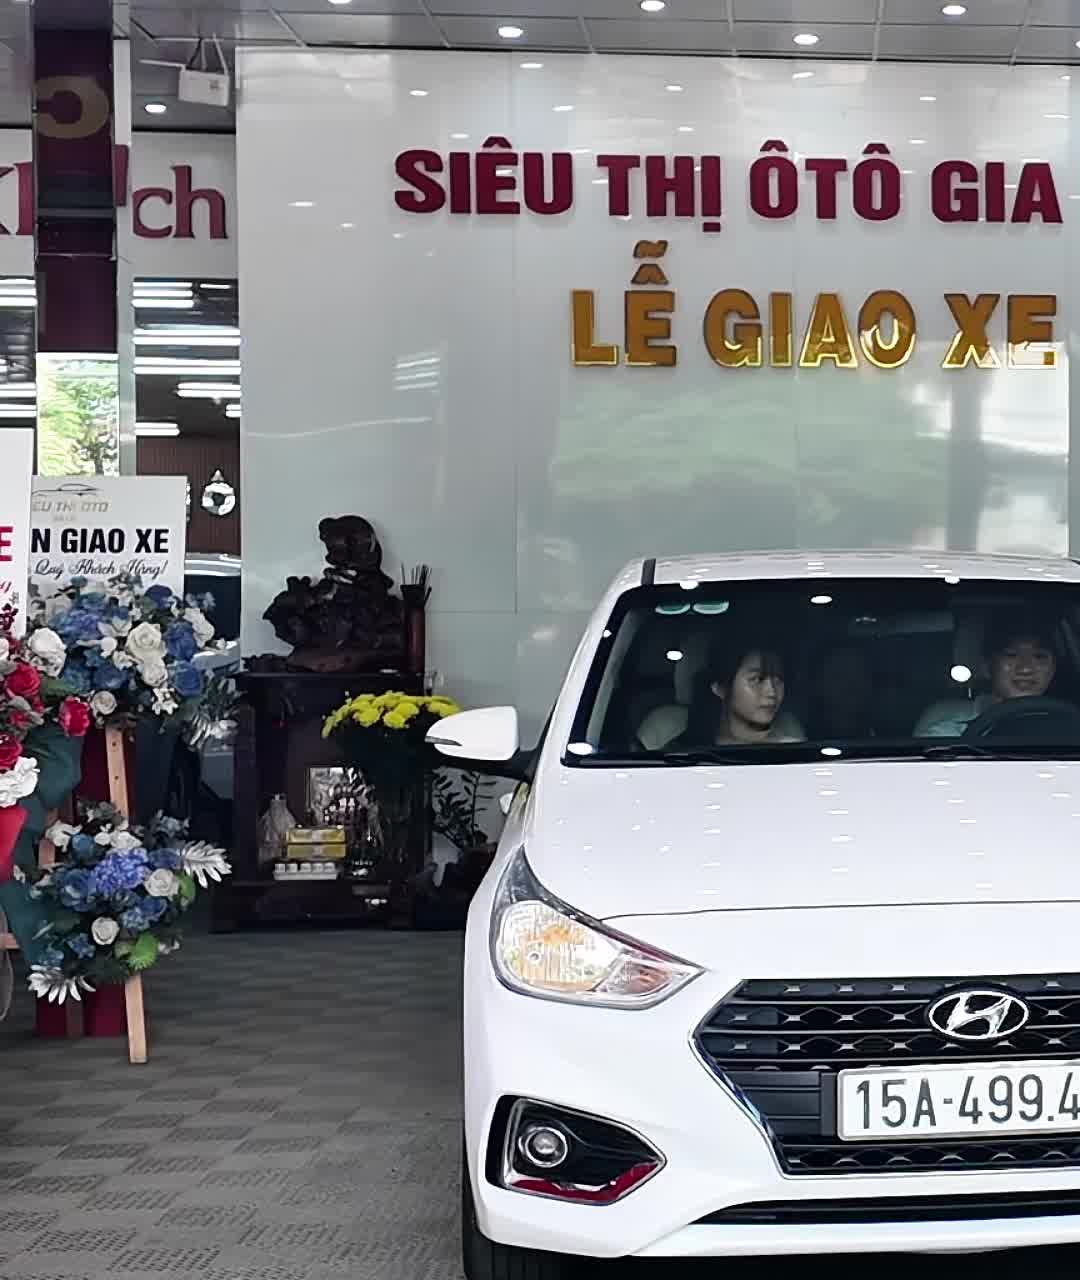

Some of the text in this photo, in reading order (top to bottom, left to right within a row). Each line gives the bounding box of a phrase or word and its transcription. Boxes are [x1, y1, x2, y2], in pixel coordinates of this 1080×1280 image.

[393, 136, 574, 216] SIÊU
[597, 153, 722, 233] THỊ
[749, 139, 902, 222] ÔTÔ
[931, 160, 1063, 225] GIA
[570, 240, 1058, 370] LỄ GIAO XE
[60, 528, 125, 554] GIAO
[134, 528, 170, 553] XE
